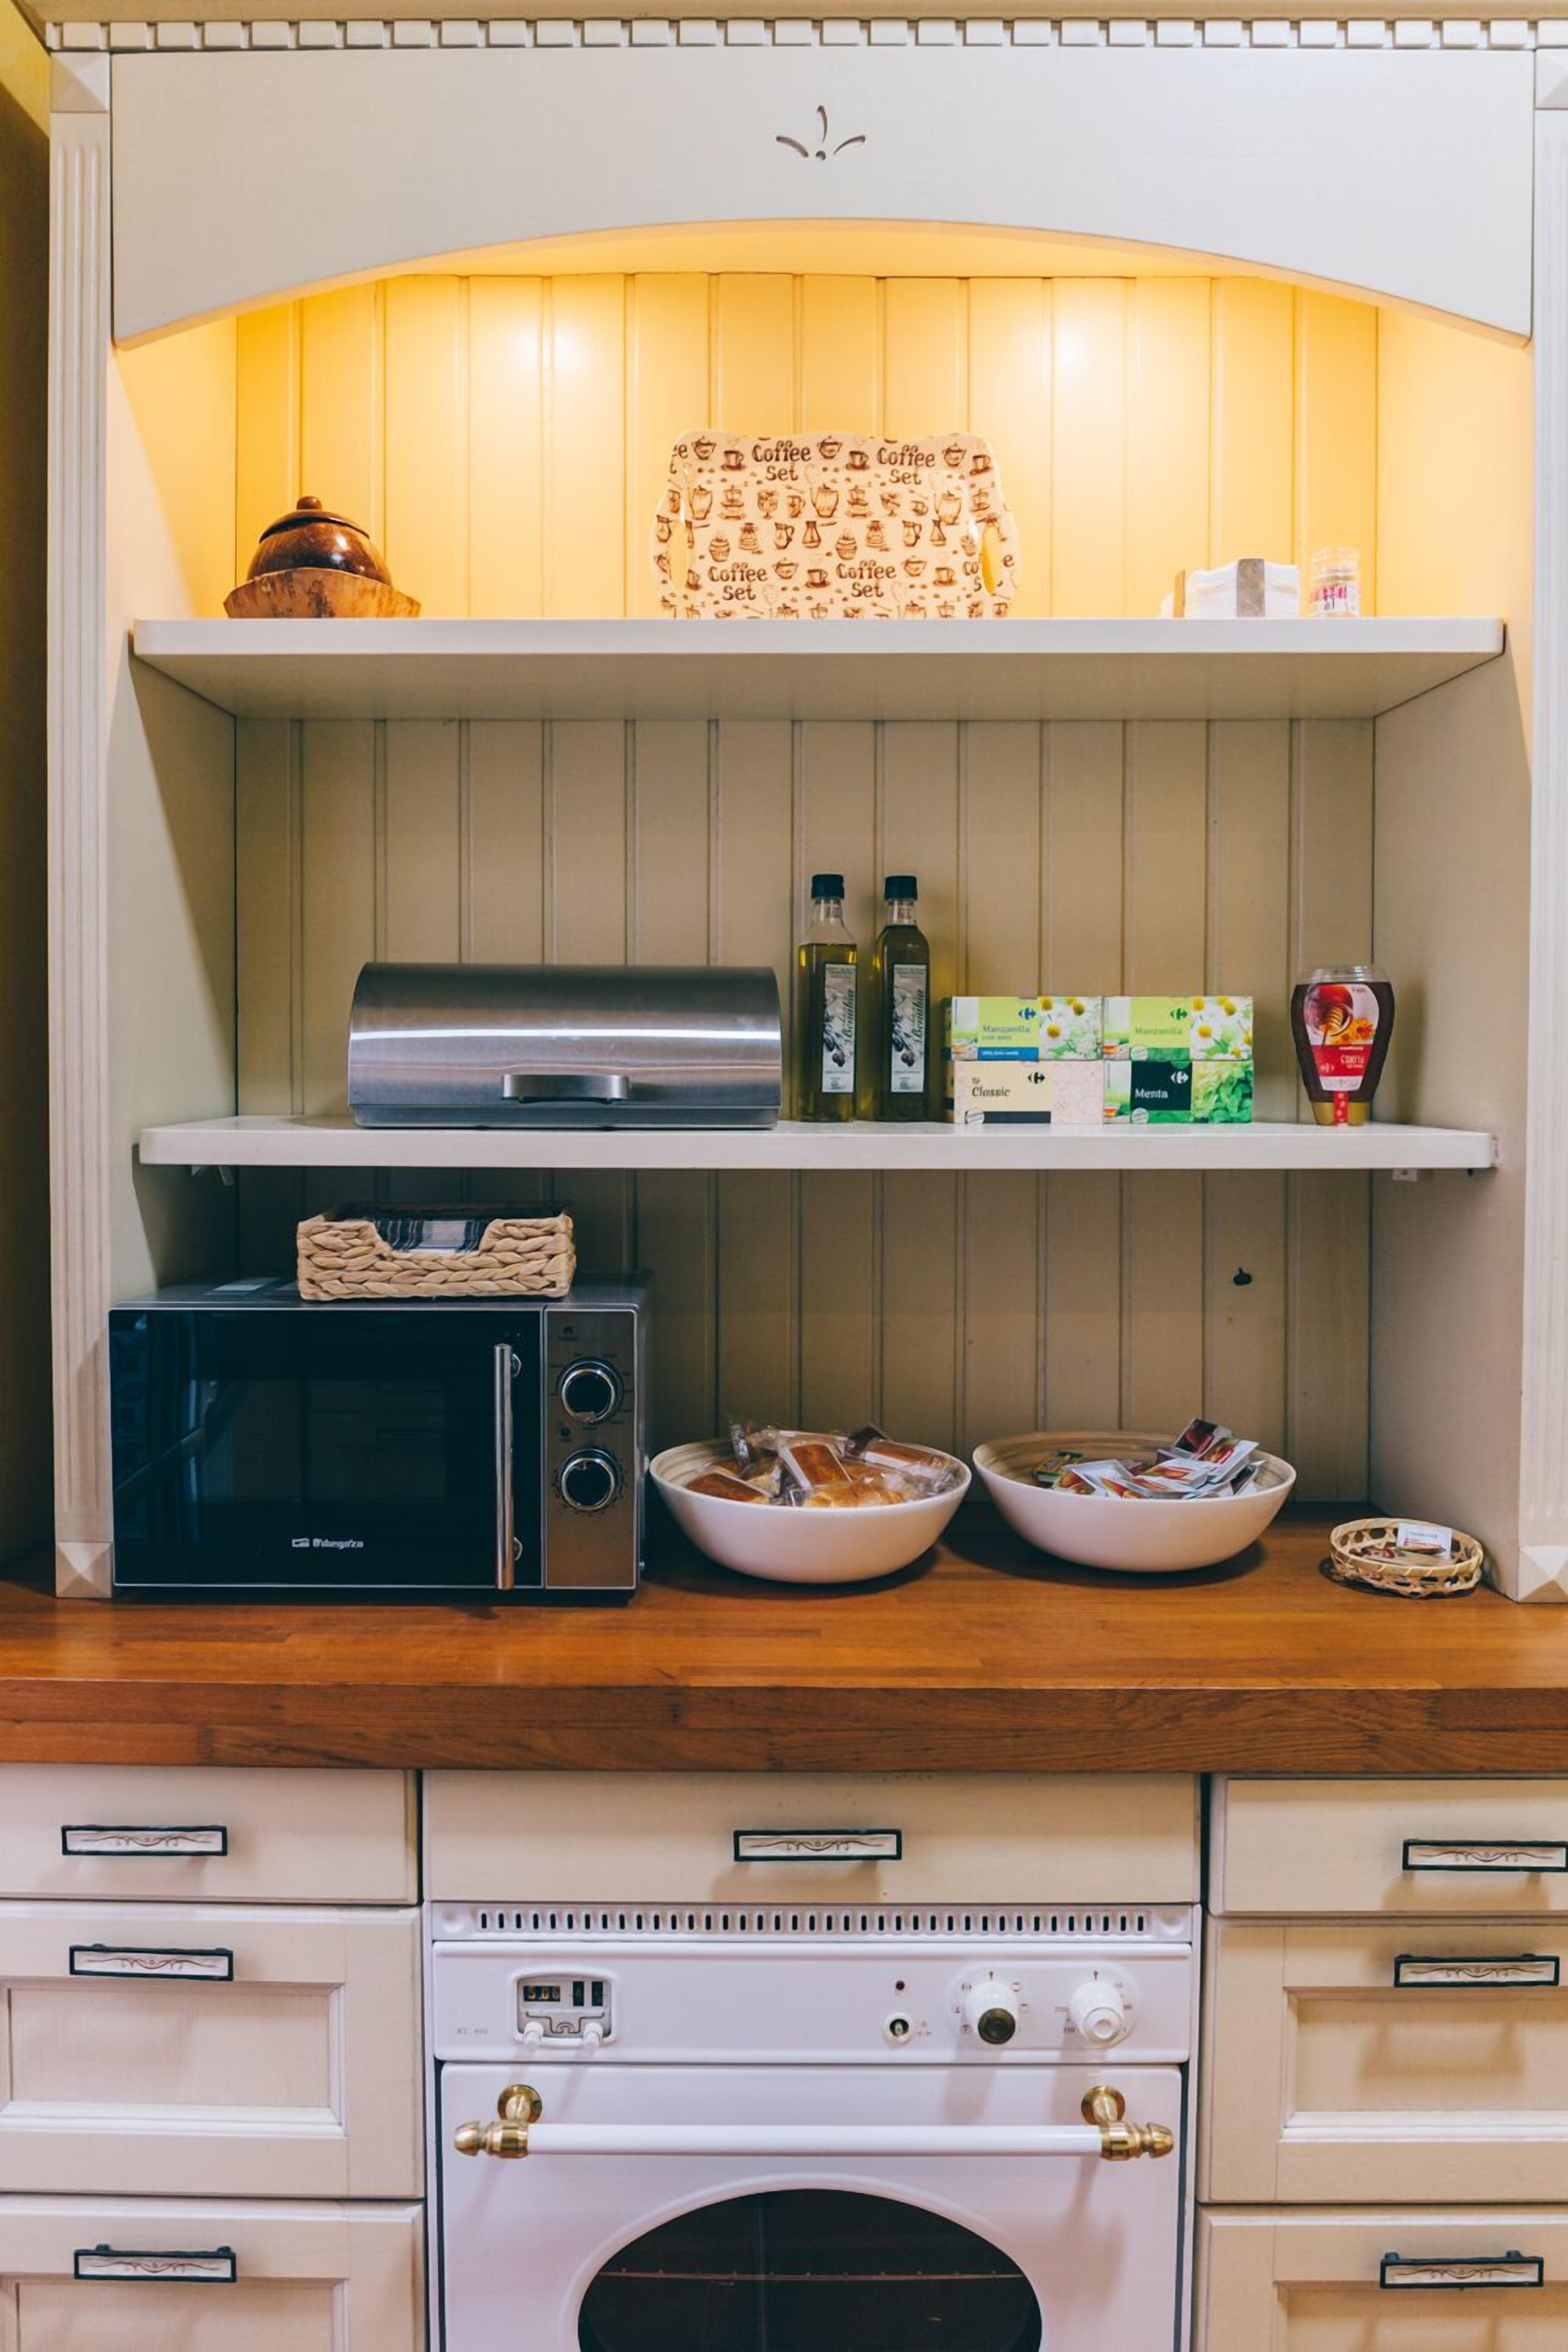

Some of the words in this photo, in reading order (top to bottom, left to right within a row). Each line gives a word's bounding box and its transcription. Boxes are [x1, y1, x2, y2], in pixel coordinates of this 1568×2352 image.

[752, 440, 811, 462] Coffee
[877, 445, 935, 468] Coffee
[765, 461, 799, 481] Set
[889, 468, 922, 485] Set
[708, 562, 768, 582] Coffee
[836, 559, 897, 580] Coffee
[723, 585, 756, 601] Set
[851, 579, 884, 598] Set
[972, 1086, 1010, 1097] Classic
[1135, 1088, 1169, 1098] Menta
